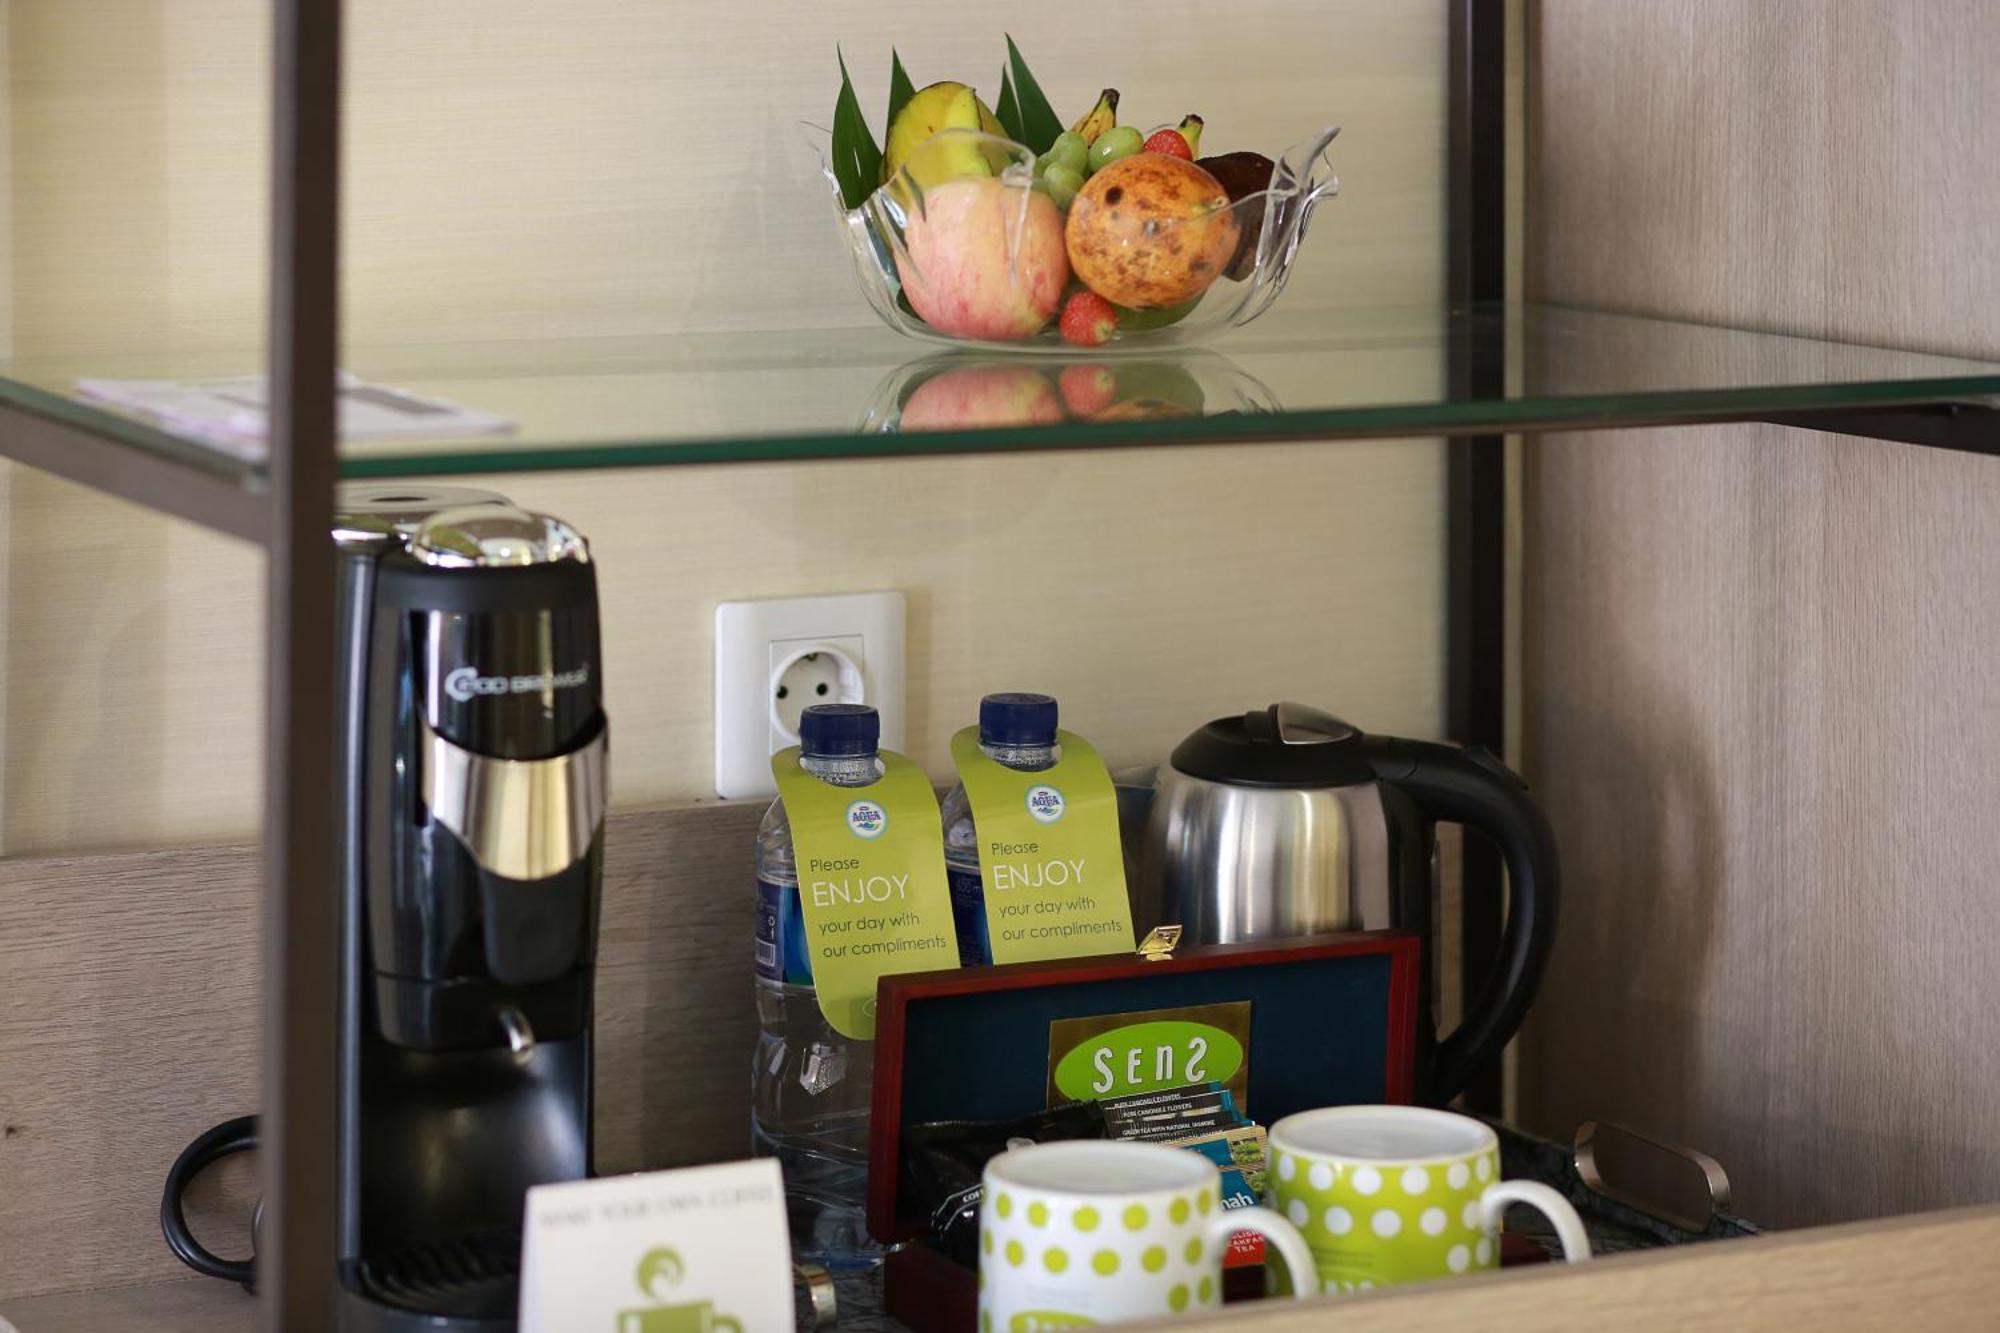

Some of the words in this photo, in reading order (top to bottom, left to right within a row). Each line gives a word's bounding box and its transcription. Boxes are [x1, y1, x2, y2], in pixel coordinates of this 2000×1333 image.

[991, 842, 1039, 856] Please
[810, 856, 860, 872] Please
[992, 858, 1085, 890] ENJOY
[812, 873, 909, 907] ENJOY
[999, 904, 1030, 918] your
[1034, 900, 1062, 915] day
[1066, 897, 1096, 911] with
[819, 920, 852, 936] your
[856, 917, 885, 932] day
[889, 912, 920, 927] with
[1002, 929, 1026, 941] our
[1030, 920, 1122, 938] compliments
[823, 946, 847, 958] our
[851, 934, 946, 956] compliments
